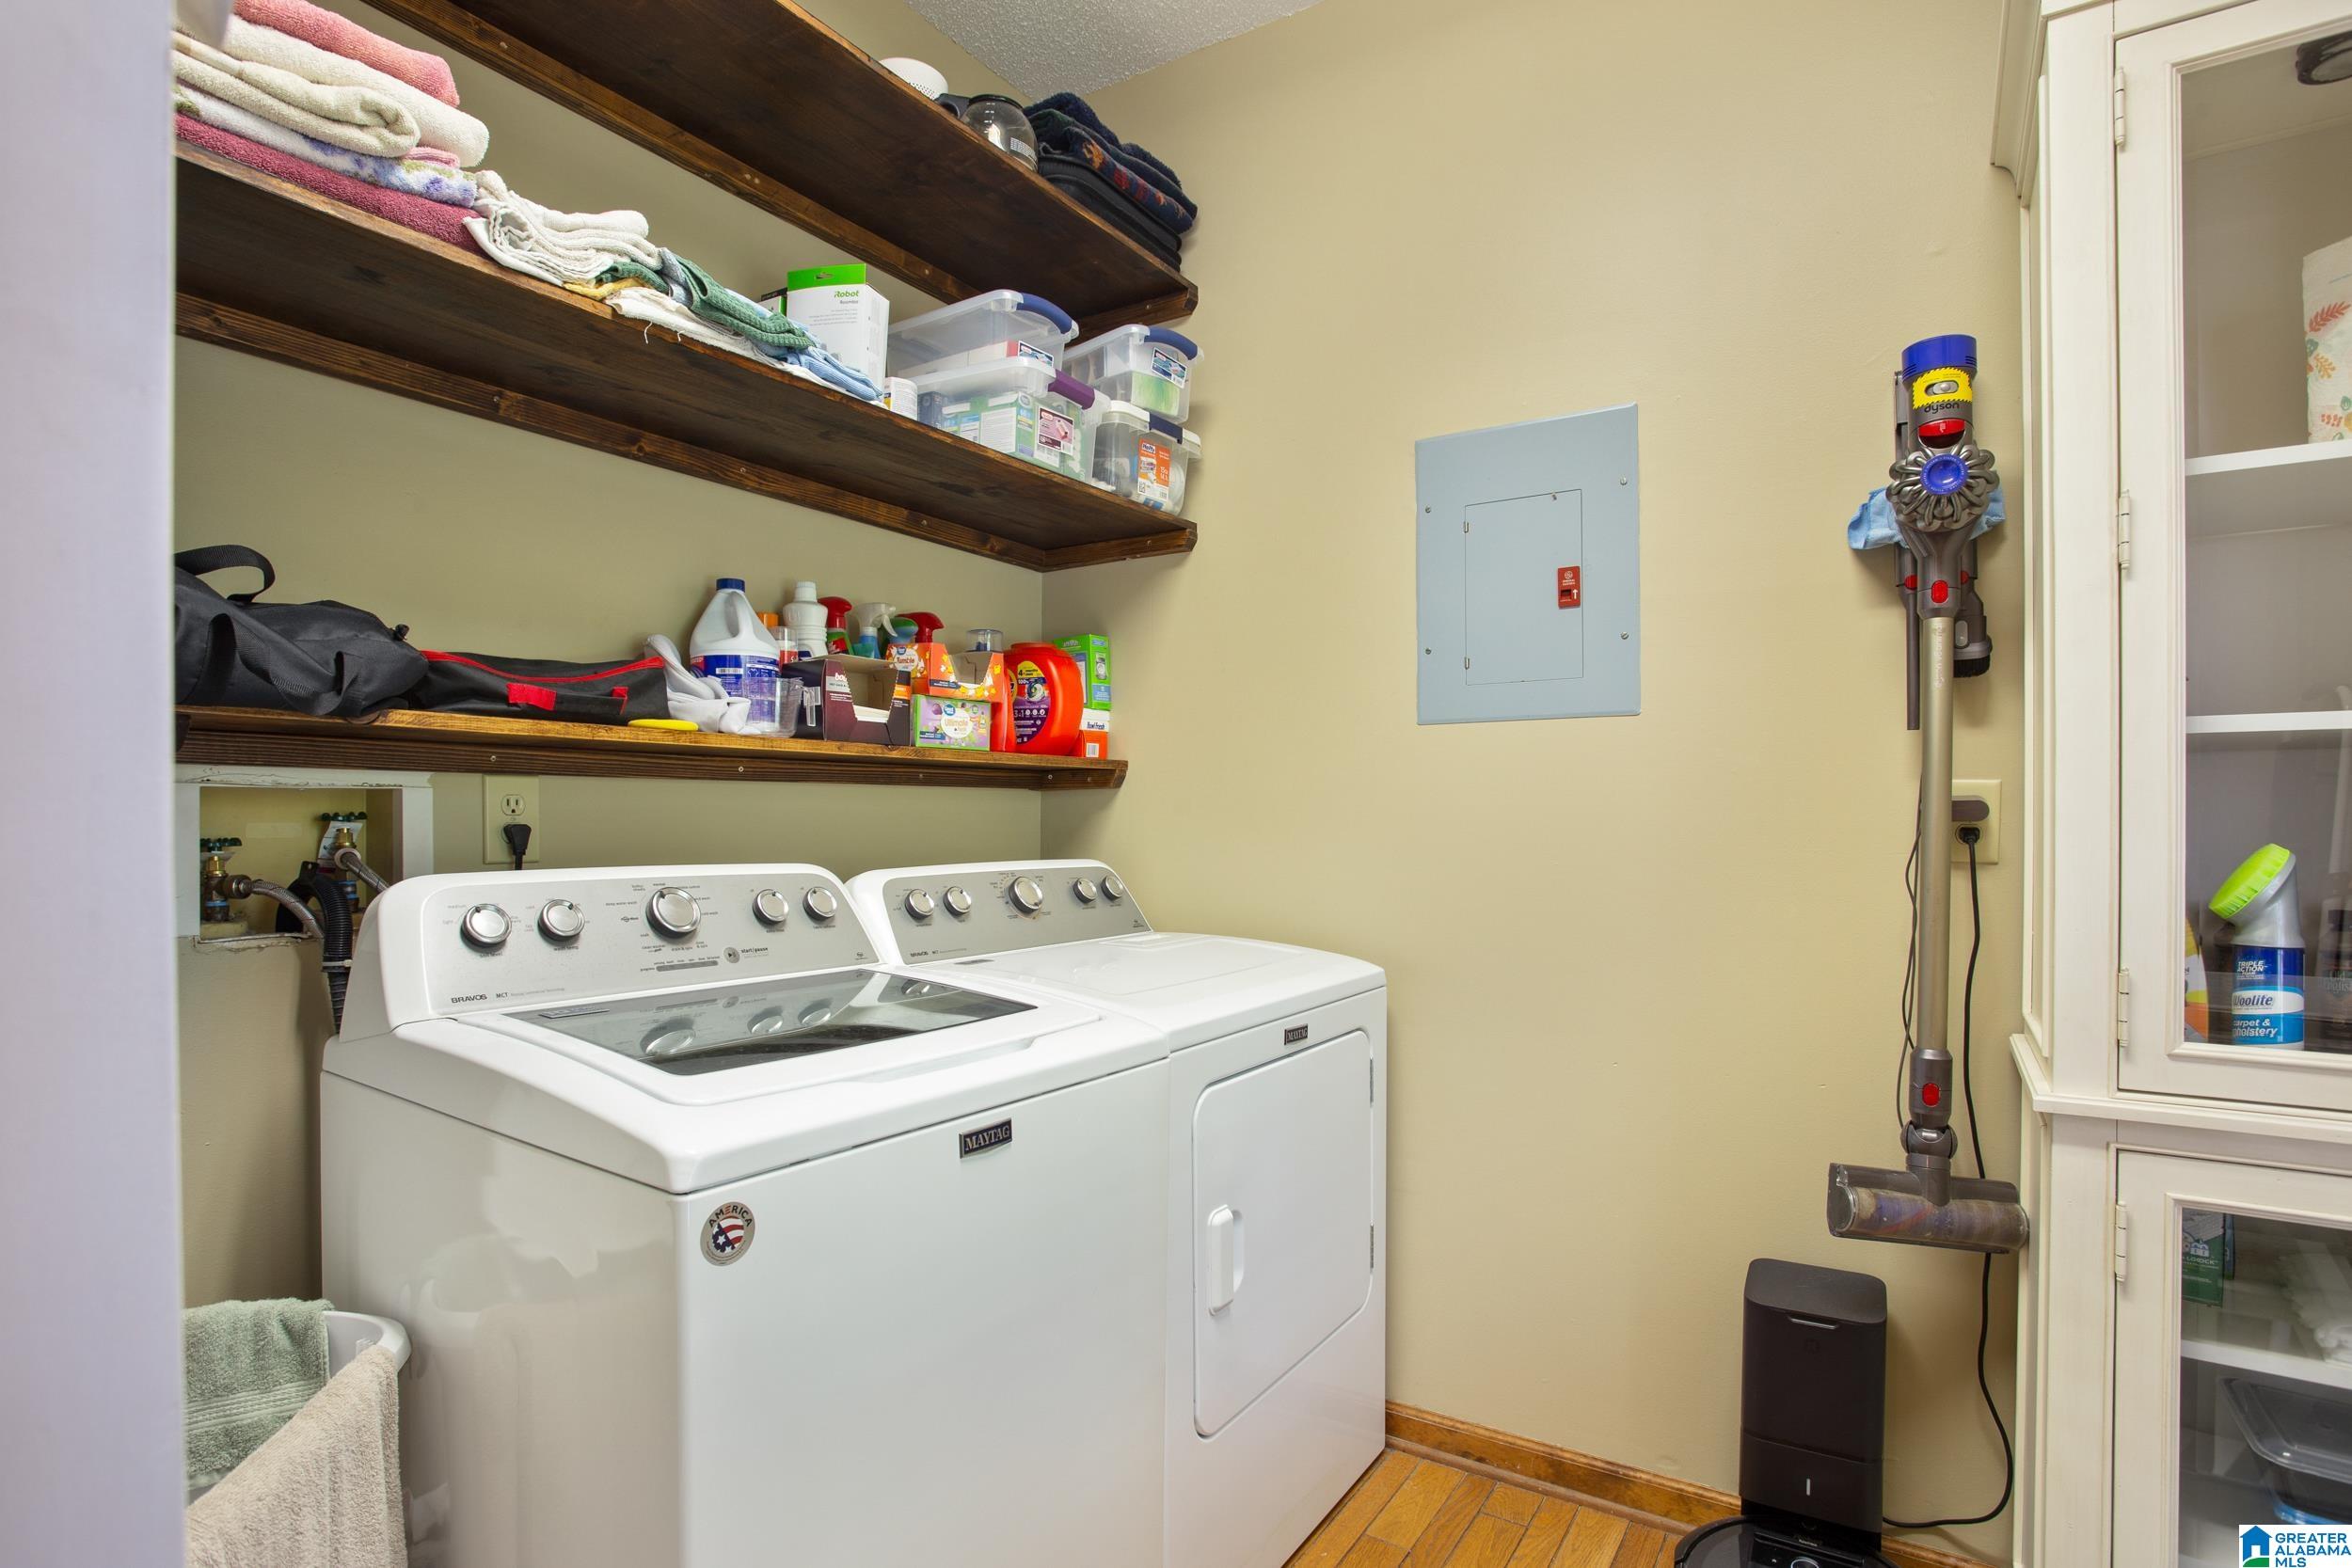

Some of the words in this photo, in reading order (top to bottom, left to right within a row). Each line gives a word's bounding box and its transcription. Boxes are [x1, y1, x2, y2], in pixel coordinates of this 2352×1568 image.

[1924, 403, 1960, 414] dyson
[451, 993, 487, 1004] BRAVOS
[2262, 1018, 2271, 1026] &
[964, 1126, 1010, 1152] MAYTAG
[708, 1205, 753, 1228] AMERICA
